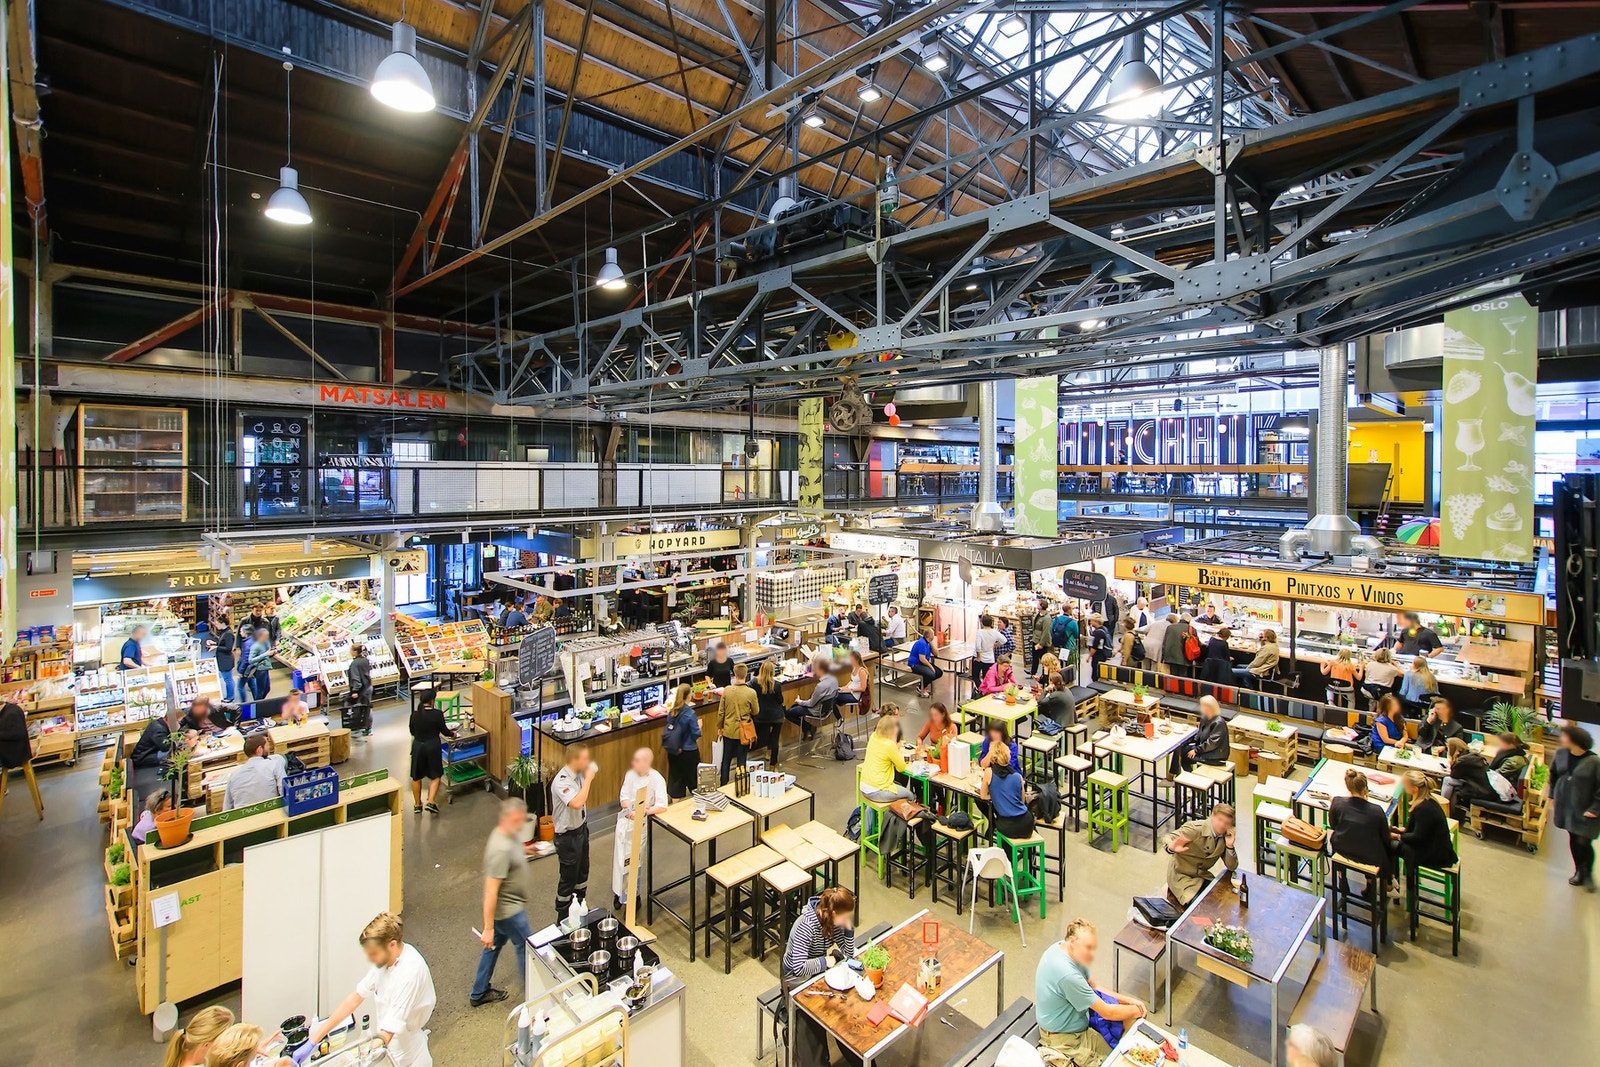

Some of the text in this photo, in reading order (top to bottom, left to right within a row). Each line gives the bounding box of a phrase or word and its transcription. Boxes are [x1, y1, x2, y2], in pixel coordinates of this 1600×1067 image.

[1472, 301, 1509, 312] OSLO
[319, 385, 446, 409] MATSALEN
[649, 536, 706, 549] HOPYARD
[1079, 543, 1111, 560] VIA ITALIA
[940, 547, 1006, 566] VIA ITALIA
[168, 565, 336, 588] FRUKT & GRØNT
[1198, 568, 1271, 591] Barramón
[1287, 577, 1341, 599] PINTXOS
[1361, 584, 1404, 606] VINOS
[181, 894, 202, 907] AST
